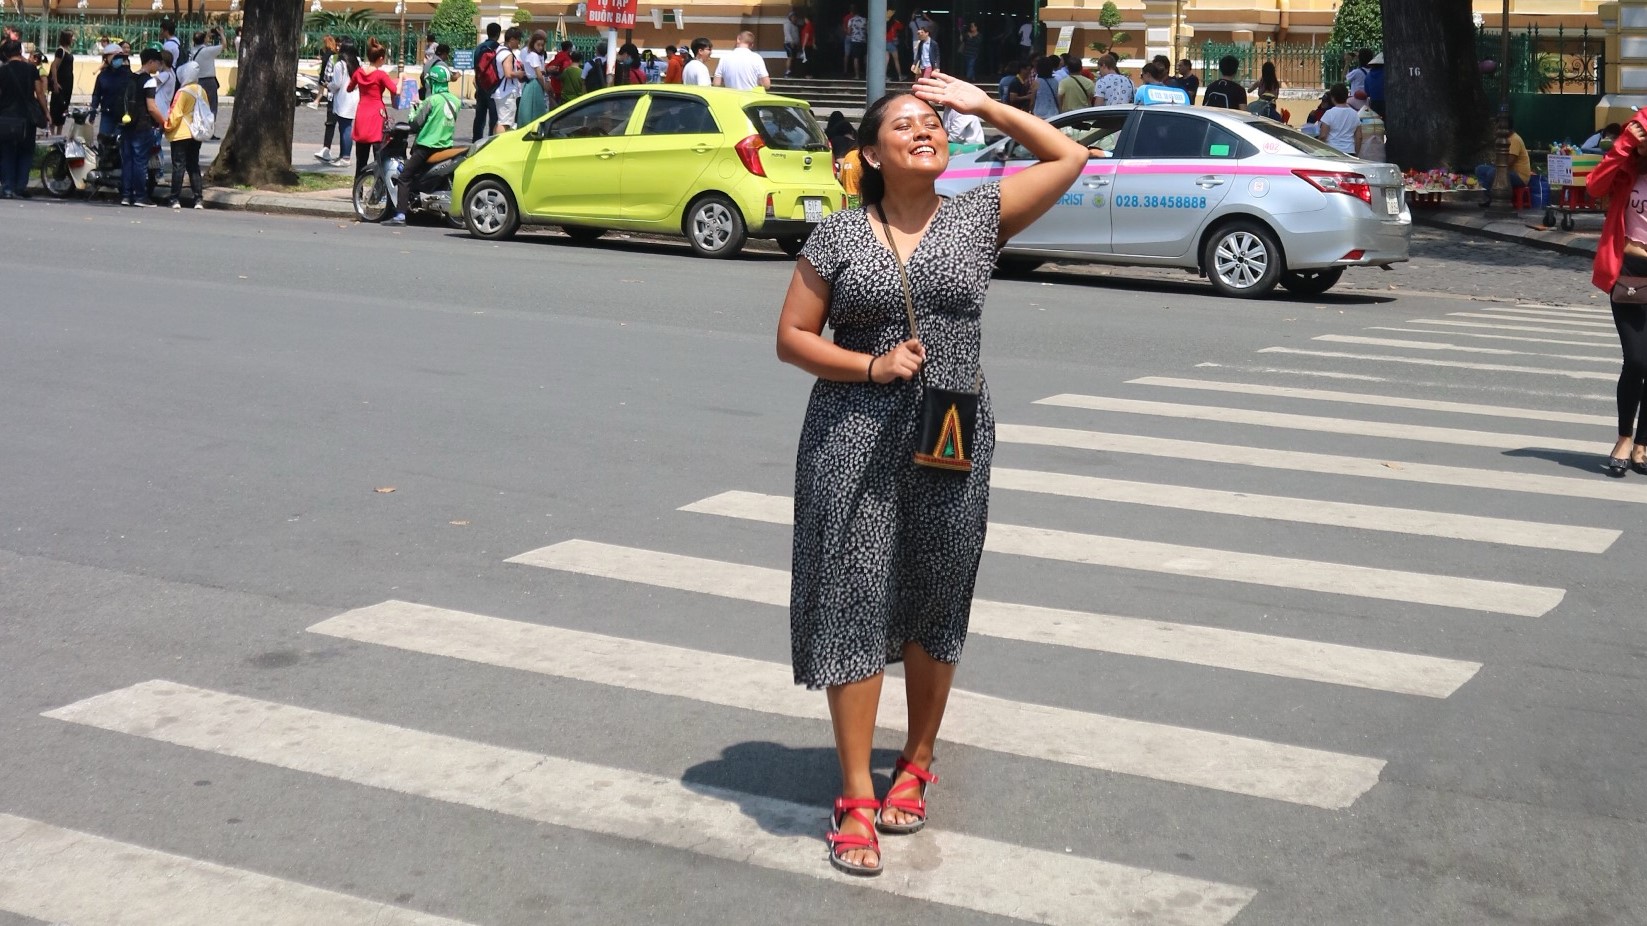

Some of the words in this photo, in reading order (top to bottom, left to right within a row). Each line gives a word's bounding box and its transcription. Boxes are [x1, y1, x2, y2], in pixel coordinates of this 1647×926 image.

[589, 9, 613, 23] BUÔN
[615, 10, 635, 25] BÁN
[1115, 194, 1207, 209] 028.38458888
